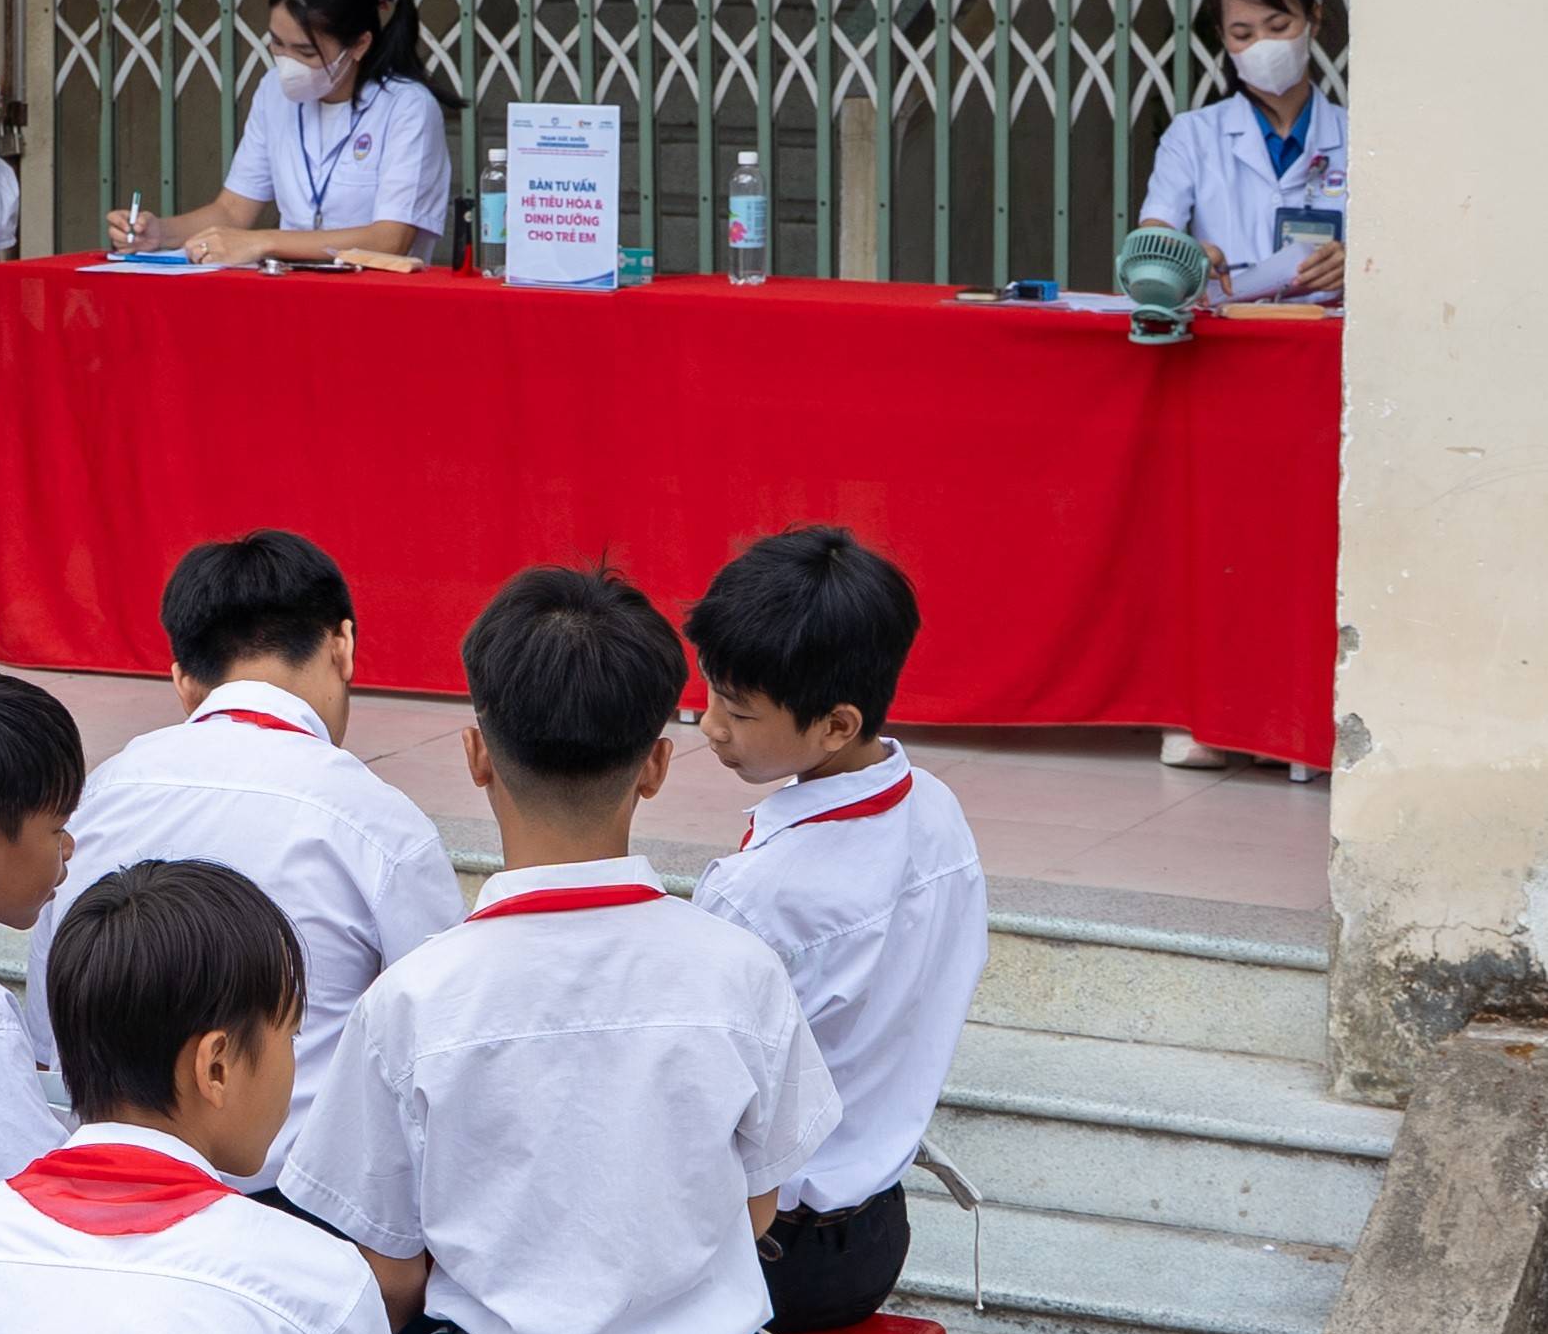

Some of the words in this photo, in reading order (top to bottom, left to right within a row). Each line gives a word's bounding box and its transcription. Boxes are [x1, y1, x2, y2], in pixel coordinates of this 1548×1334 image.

[529, 178, 554, 192] BÀN
[555, 180, 572, 192] TƯ
[572, 178, 596, 193] VẤN
[521, 194, 536, 211] HỆ
[539, 195, 564, 208] TIÊU
[566, 195, 592, 210] HÓA
[594, 200, 603, 210] &
[524, 214, 553, 225] DINH
[556, 212, 600, 227] DƯỠNG
[528, 230, 554, 241] CHO
[556, 229, 577, 242] TRẺ
[579, 232, 596, 243] EM
